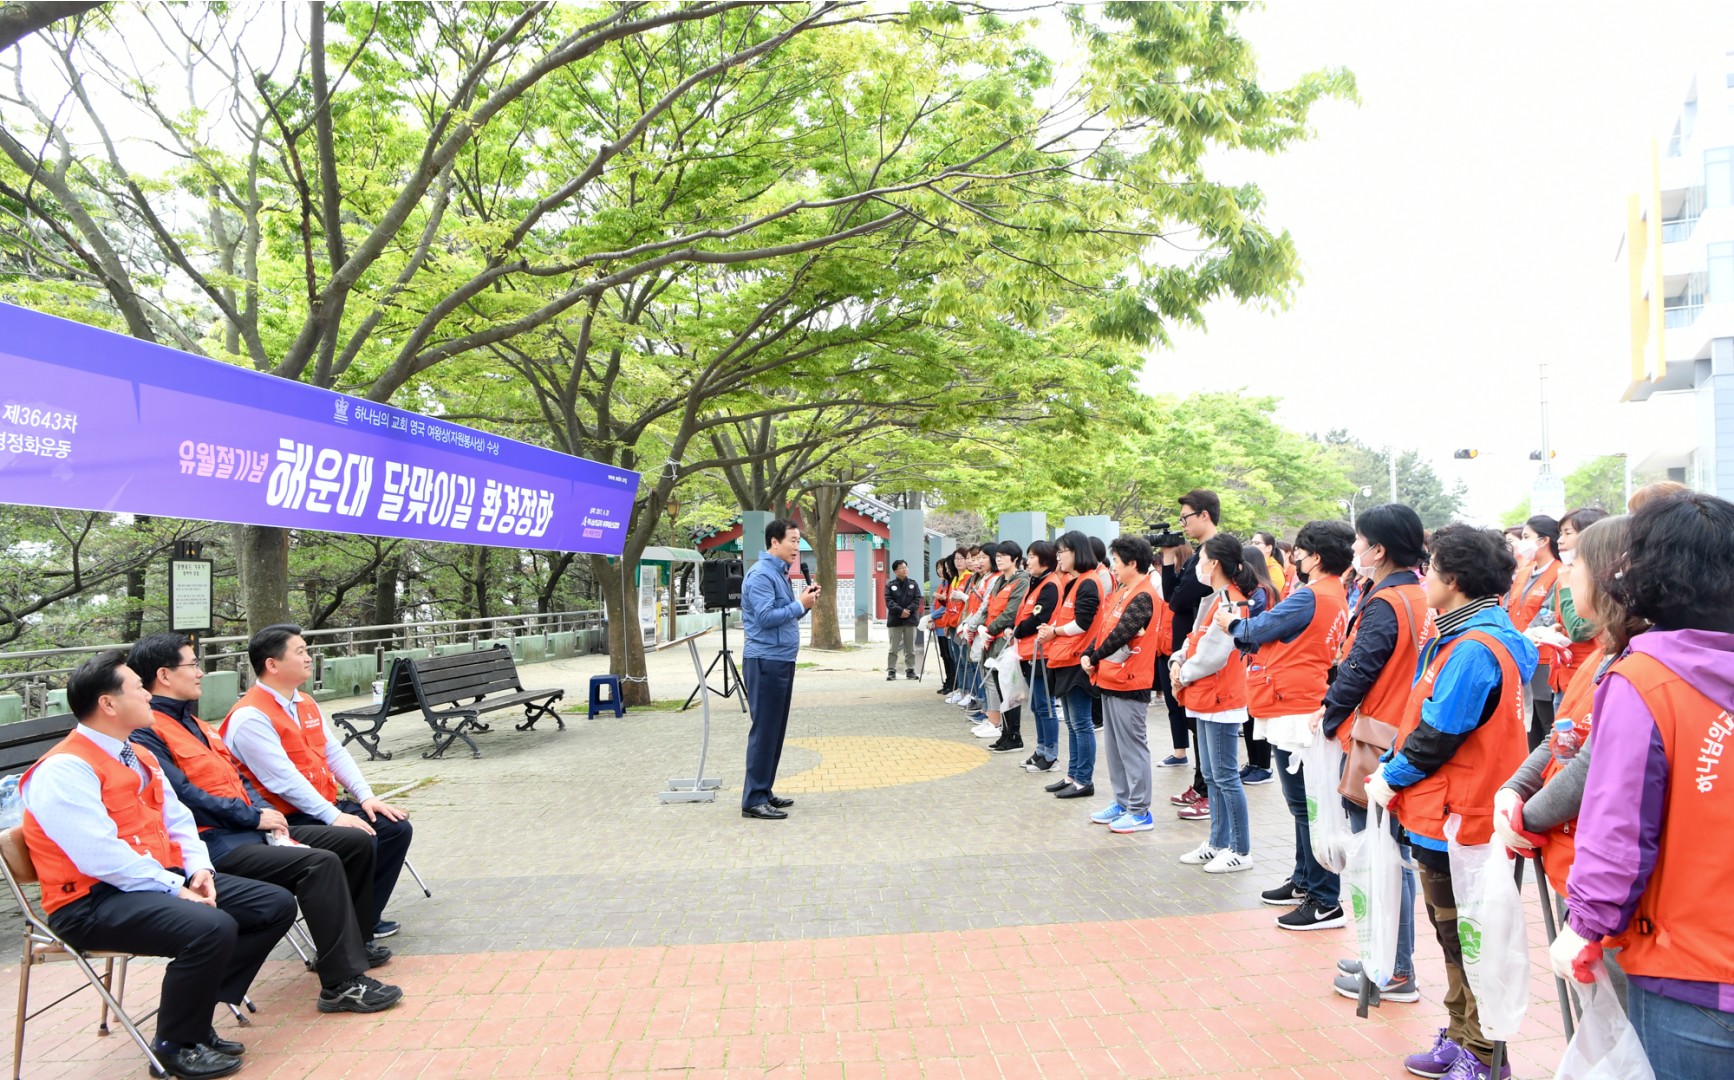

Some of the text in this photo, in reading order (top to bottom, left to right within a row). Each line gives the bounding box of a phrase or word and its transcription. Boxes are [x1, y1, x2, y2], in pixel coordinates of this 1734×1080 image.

[2, 404, 78, 434] 제3643차
[354, 405, 389, 428] 하나님의
[391, 416, 408, 432] 교회
[410, 420, 425, 437] 영국
[487, 440, 500, 456] 수상
[178, 438, 555, 538] 유월절기념 해운대 달맞이길 환경정화
